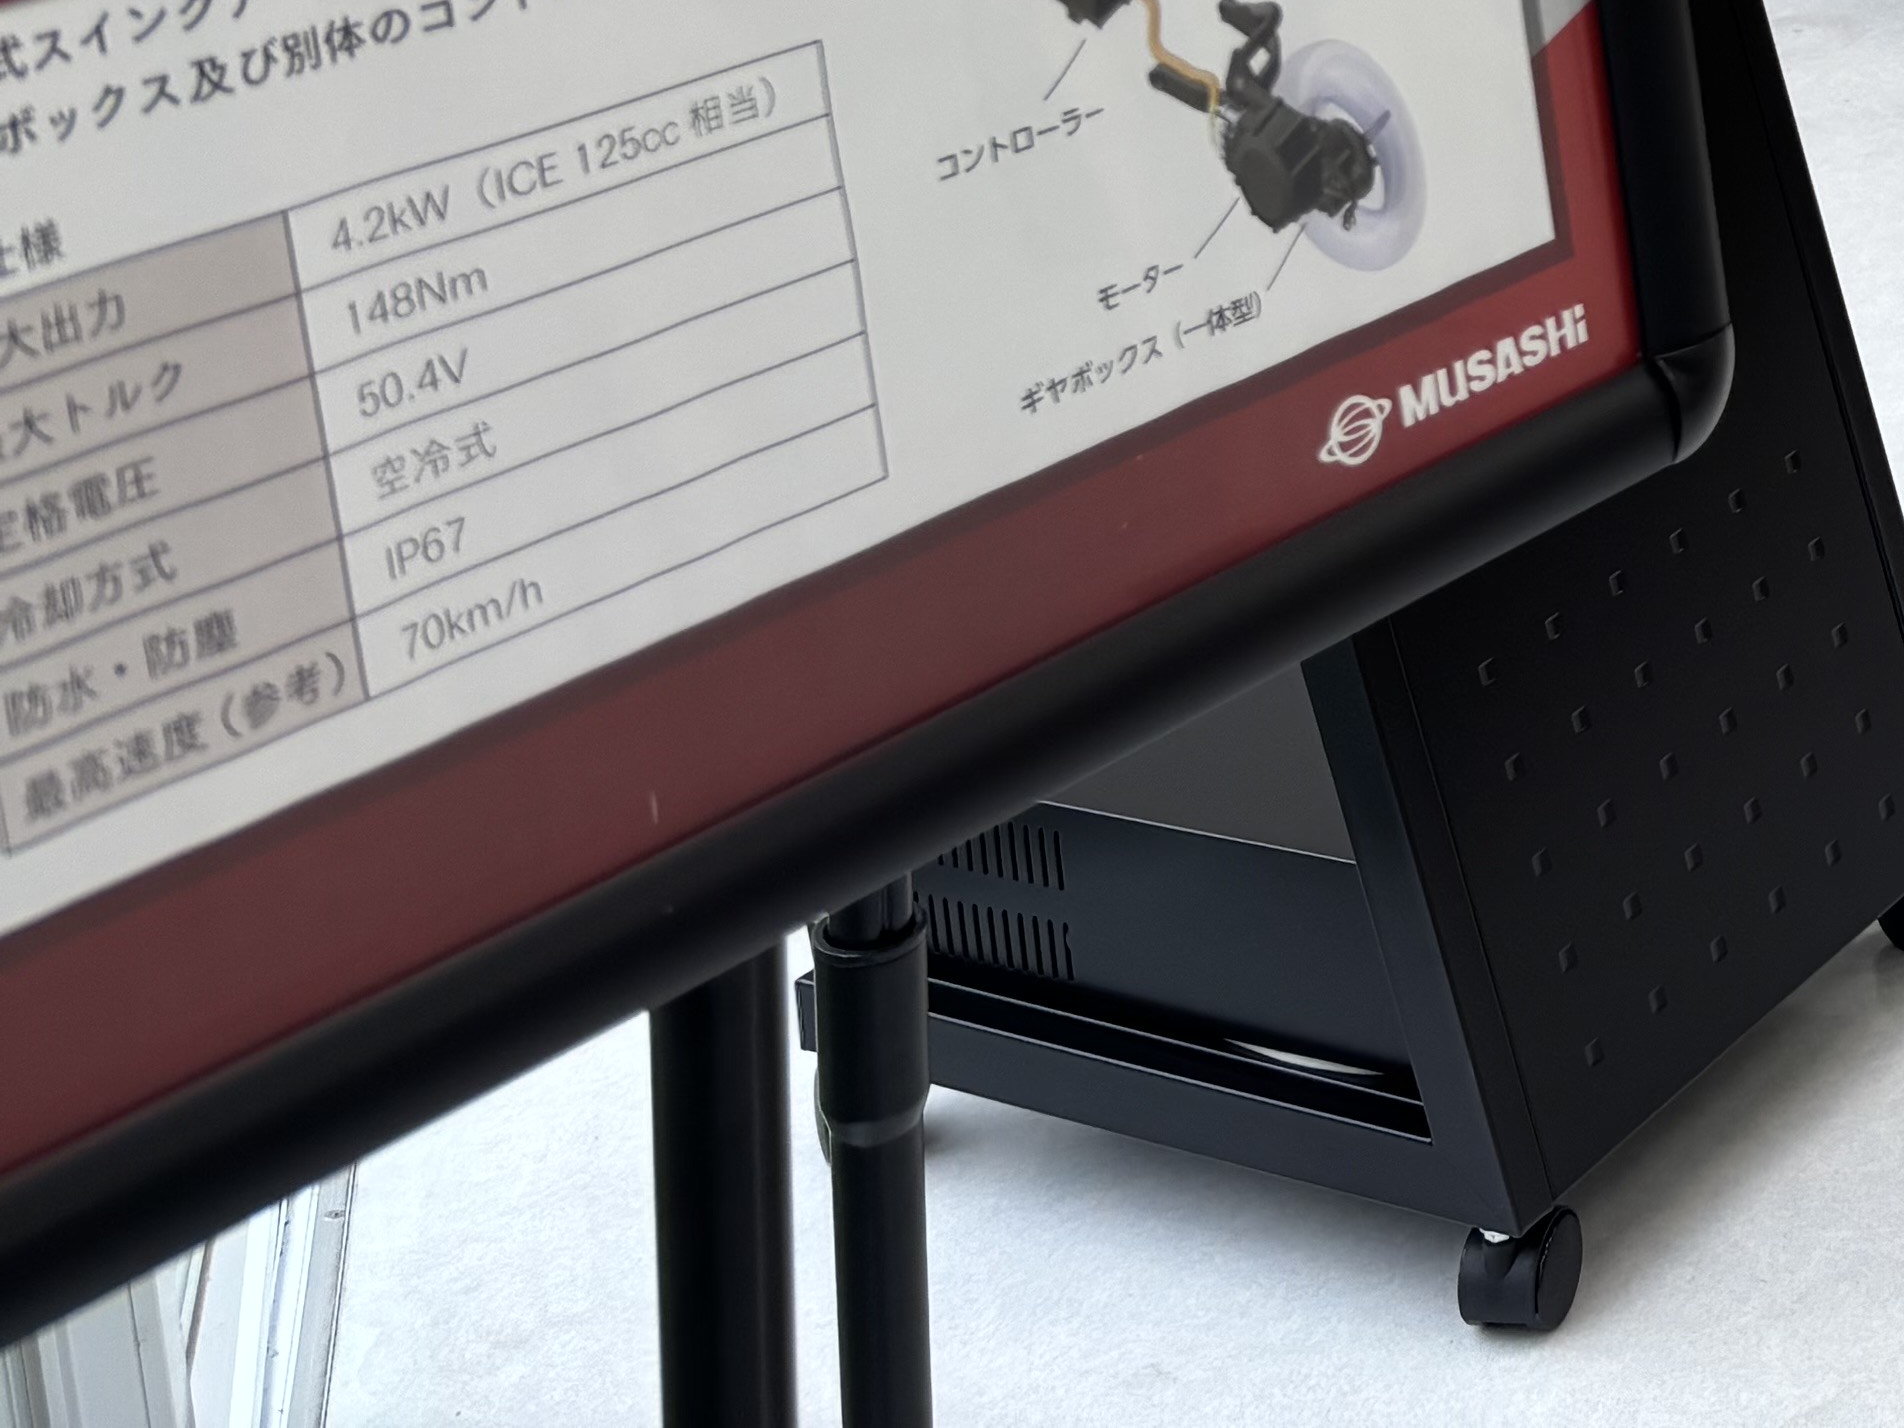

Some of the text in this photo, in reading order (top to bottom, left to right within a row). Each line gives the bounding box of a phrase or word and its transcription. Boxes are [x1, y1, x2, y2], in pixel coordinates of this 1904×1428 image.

[935, 105, 1106, 182] コントローラー
[329, 183, 451, 255] 4.2kW
[576, 116, 682, 177] 125cc
[346, 264, 490, 336] 148Nm
[1097, 262, 1185, 312] モーター
[0, 359, 184, 459] 大トルク
[356, 348, 469, 419] 50.4V
[368, 421, 499, 498] 空冷式
[385, 517, 469, 579] IP67
[0, 540, 178, 646] 冷却方式
[401, 575, 545, 659] 70km/h
[3, 607, 239, 737] 防水・防塵
